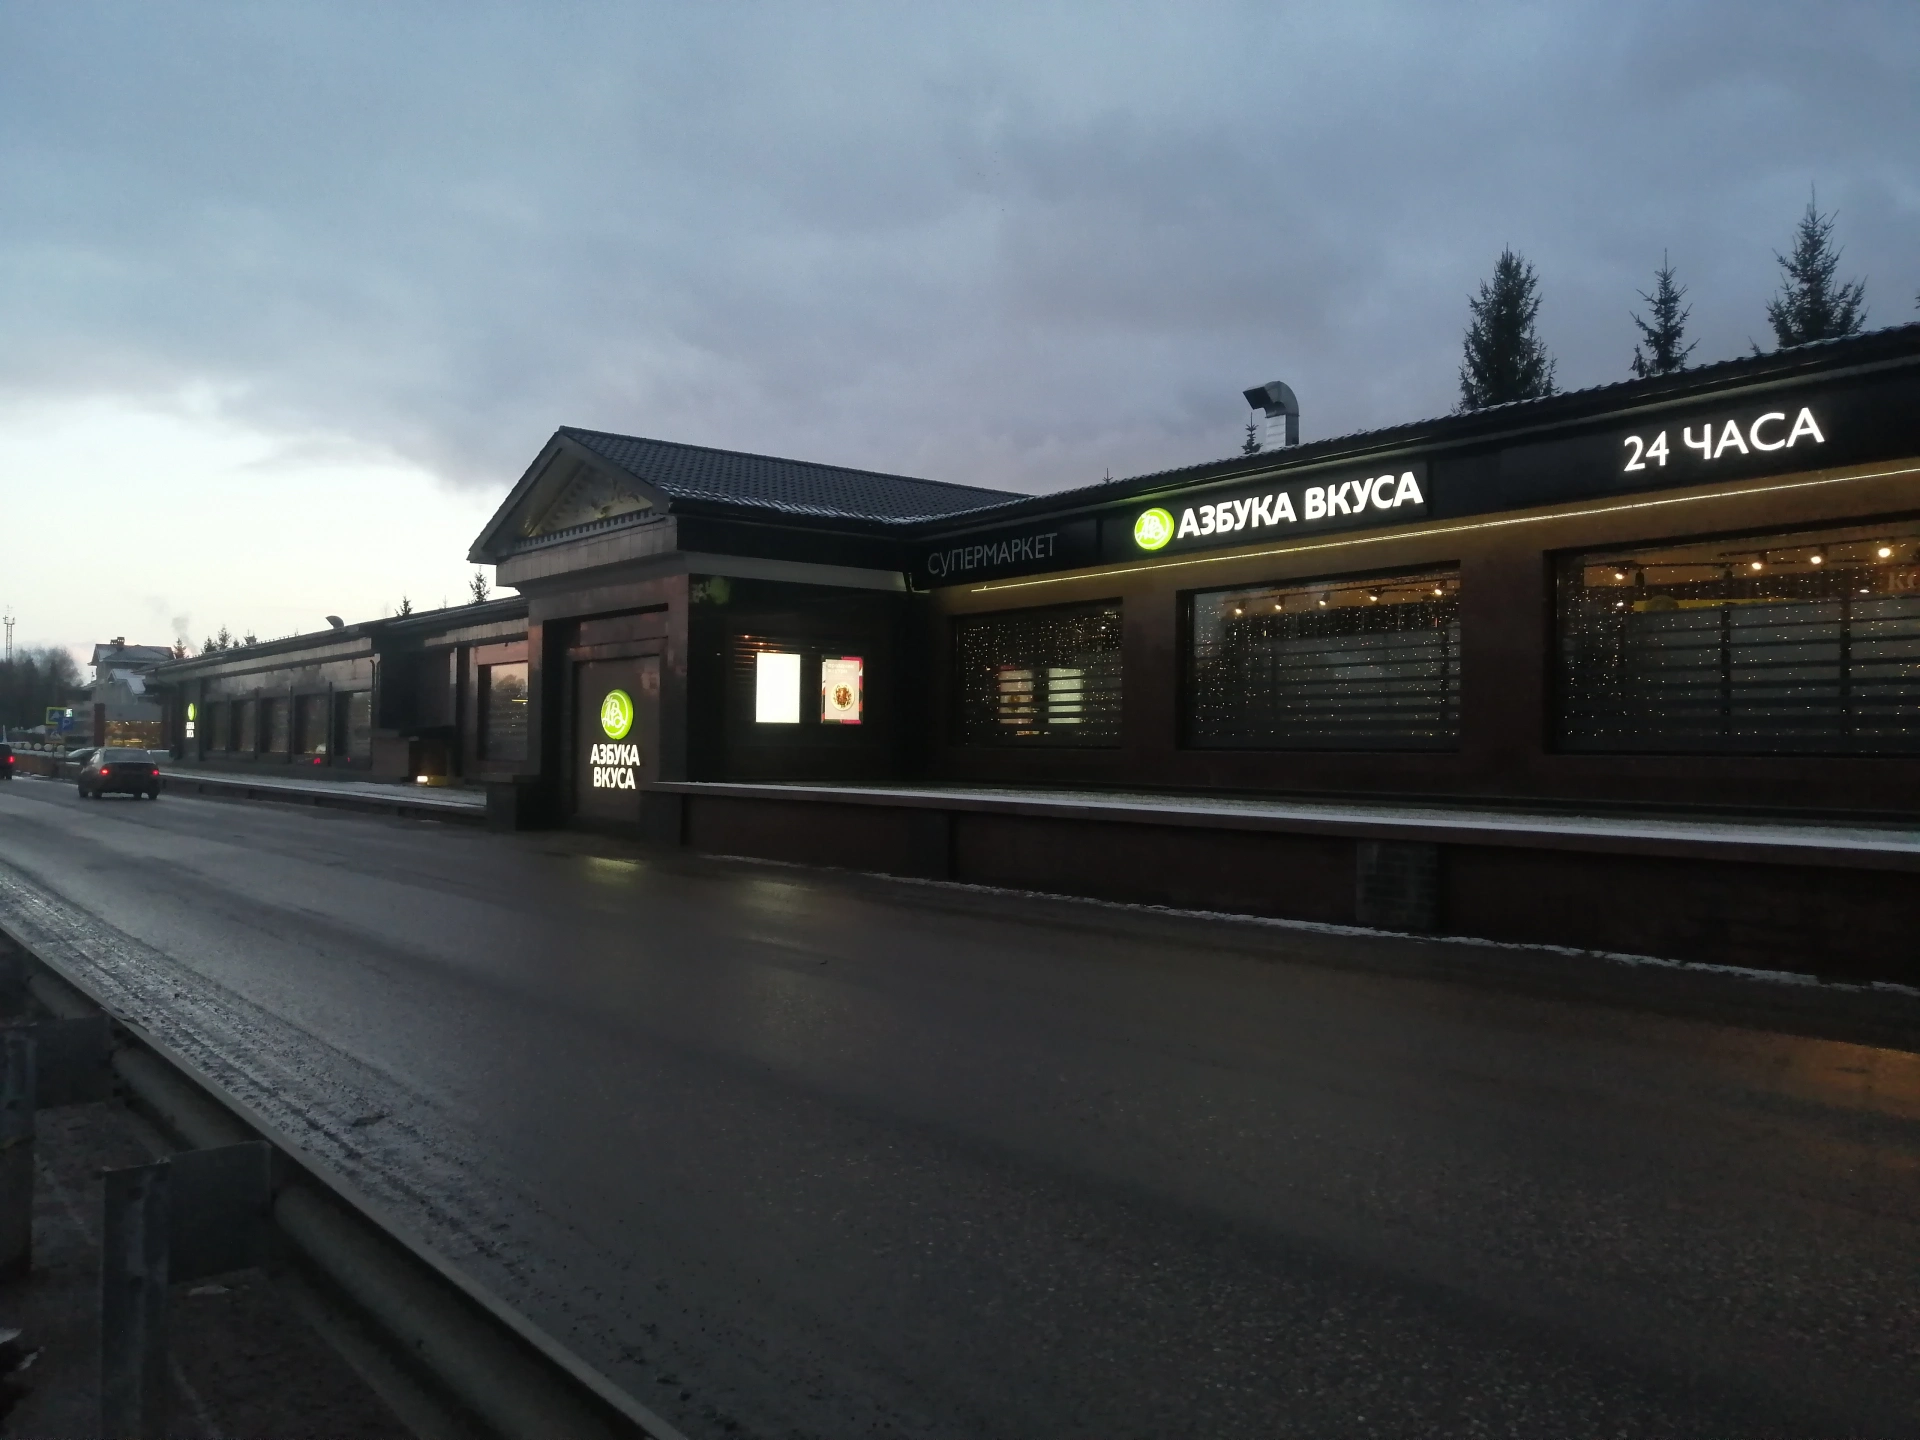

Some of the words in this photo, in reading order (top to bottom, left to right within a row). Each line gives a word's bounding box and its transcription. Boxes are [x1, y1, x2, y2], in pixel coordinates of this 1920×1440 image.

[1623, 430, 1670, 473] 24
[1683, 407, 1826, 460] ЧАСА
[1176, 491, 1298, 539] АЗБУКА
[1304, 471, 1424, 521] ВКУСА
[927, 531, 1058, 577] СУПЕРМАРКЕТ
[590, 743, 640, 767] АЗБУКА
[593, 766, 636, 790] ВКУСА
